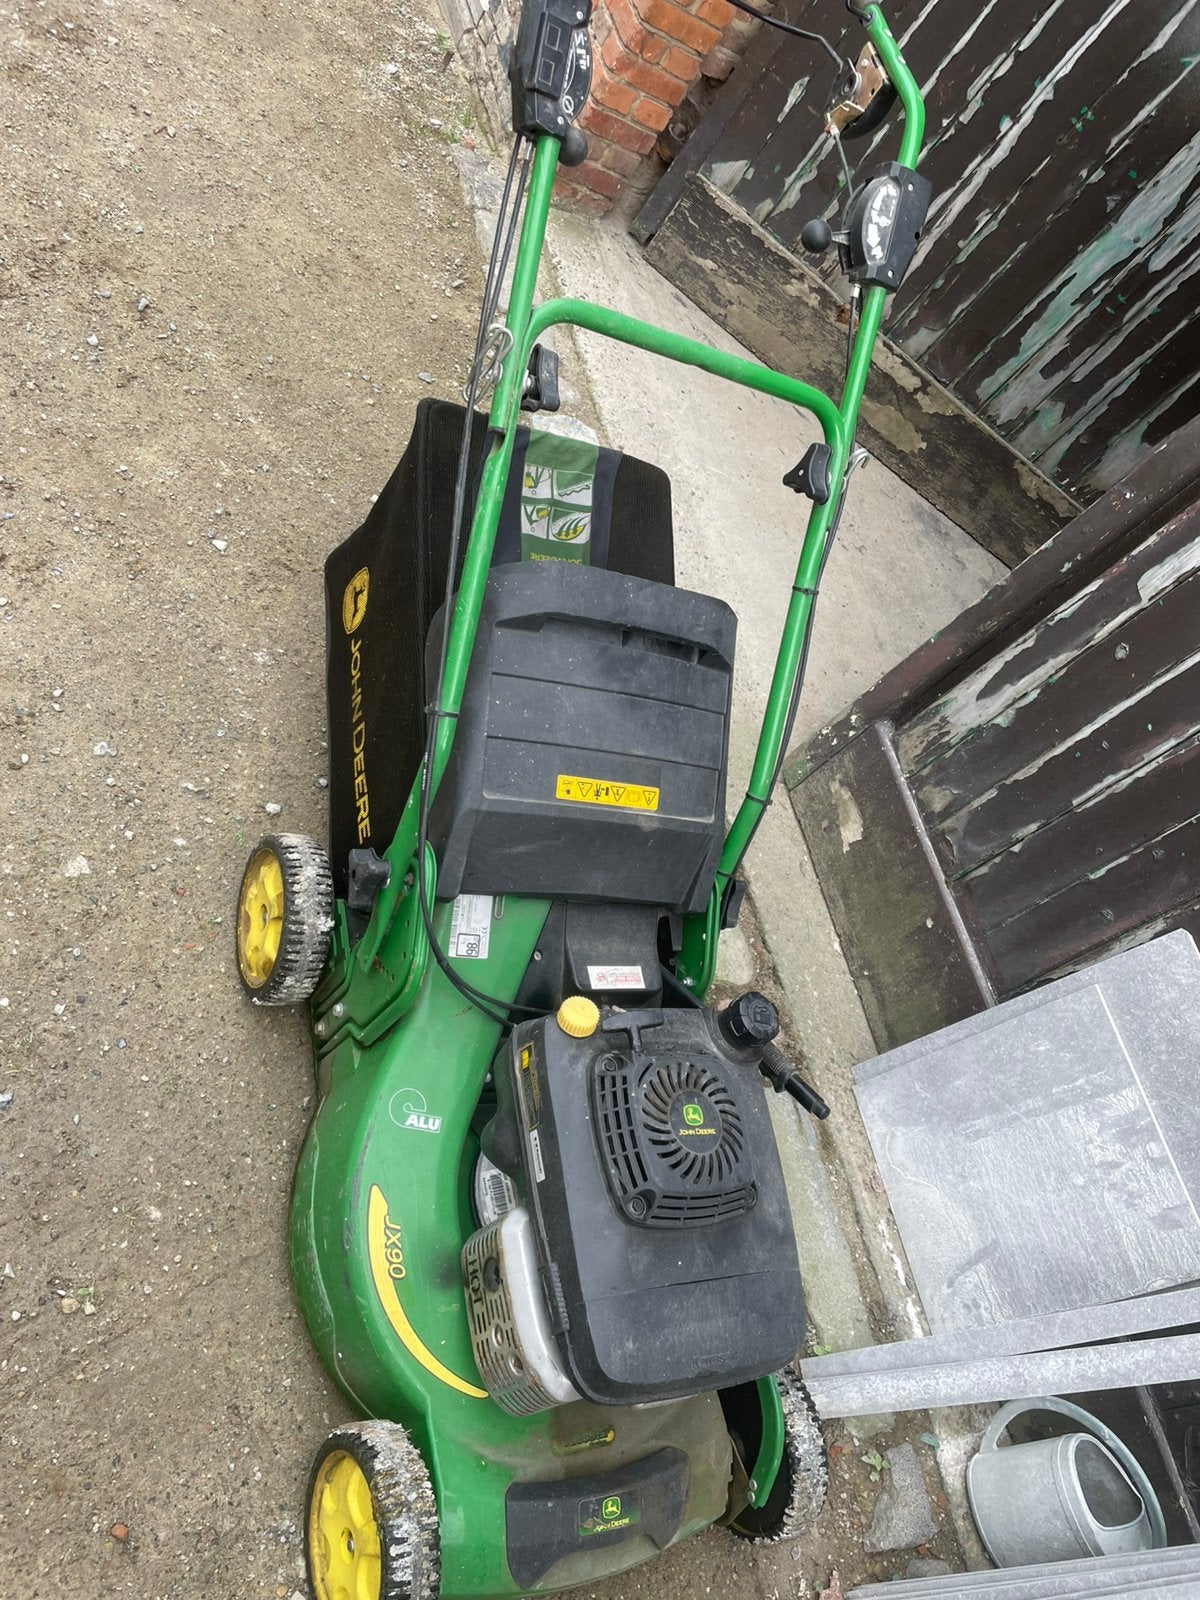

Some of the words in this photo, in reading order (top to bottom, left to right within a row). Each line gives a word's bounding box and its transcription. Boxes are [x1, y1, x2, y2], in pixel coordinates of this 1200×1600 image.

[350, 638, 363, 724] JOHN
[351, 721, 371, 846] DEERE
[466, 942, 478, 955] 98
[404, 1113, 440, 1131] ALU
[678, 1128, 695, 1136] JOHN
[382, 1214, 407, 1281] JX90
[468, 1258, 484, 1306] HOT
[611, 1517, 630, 1527] DEERE
